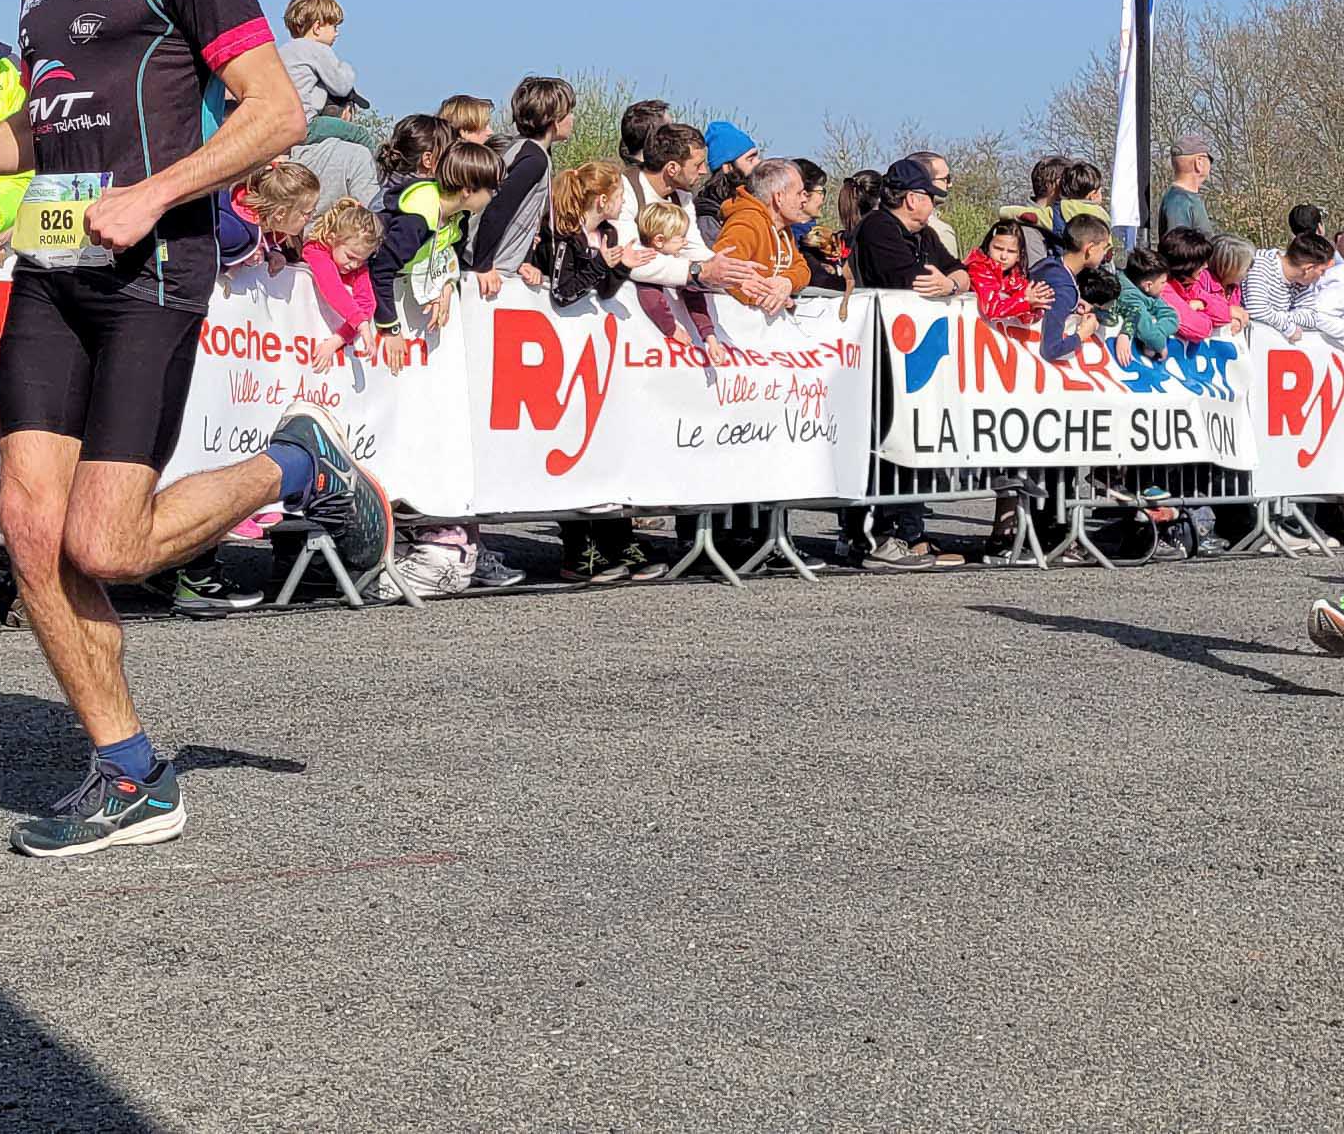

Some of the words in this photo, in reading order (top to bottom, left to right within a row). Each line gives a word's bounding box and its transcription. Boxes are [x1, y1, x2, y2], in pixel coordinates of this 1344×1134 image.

[53, 112, 110, 134] TRIATHLON
[41, 209, 73, 230] 826
[40, 234, 76, 245] ROMAIN
[624, 342, 662, 367] La
[229, 369, 262, 406] Ville
[266, 378, 288, 405] et
[715, 374, 758, 406] Ville
[765, 378, 783, 400] et
[204, 414, 222, 454] Le
[677, 418, 704, 448] Le
[914, 409, 957, 453] LA
[973, 408, 1112, 453] ROCHE
[1130, 408, 1197, 451] SUR
